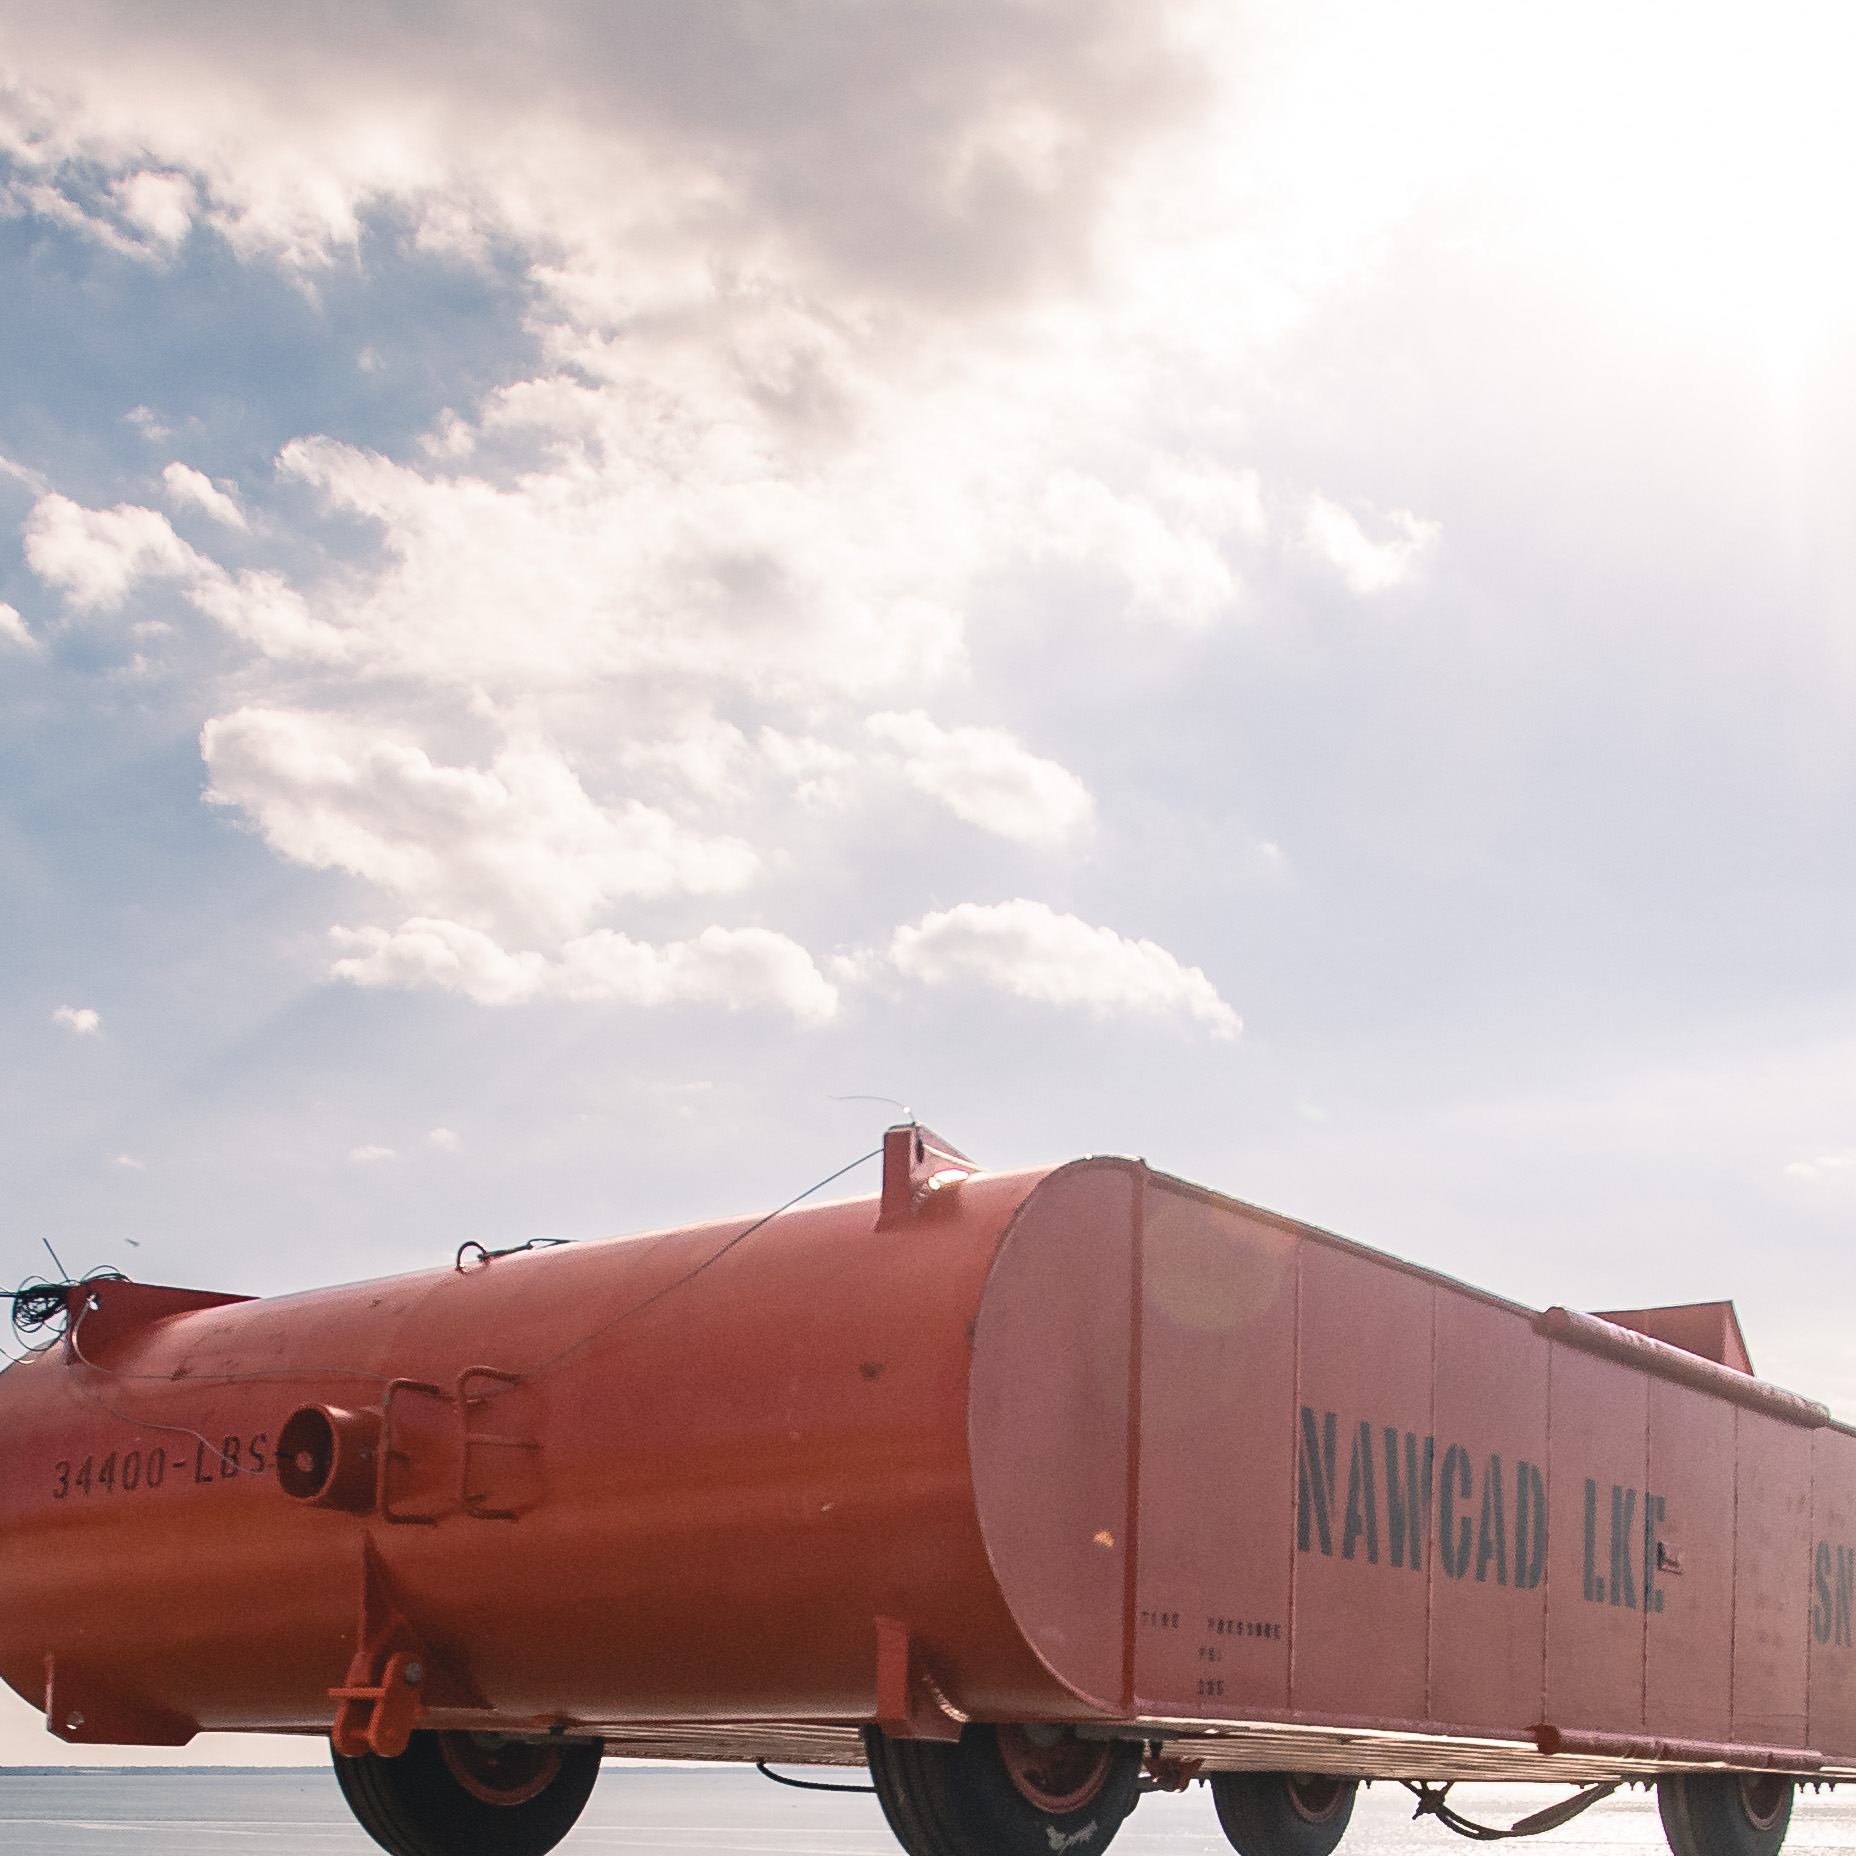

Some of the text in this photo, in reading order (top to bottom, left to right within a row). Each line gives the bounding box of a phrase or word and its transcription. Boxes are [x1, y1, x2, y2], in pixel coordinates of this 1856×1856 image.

[53, 1433, 267, 1499] 34400-LBS
[1297, 1406, 1666, 1613] NAWCAD LKE
